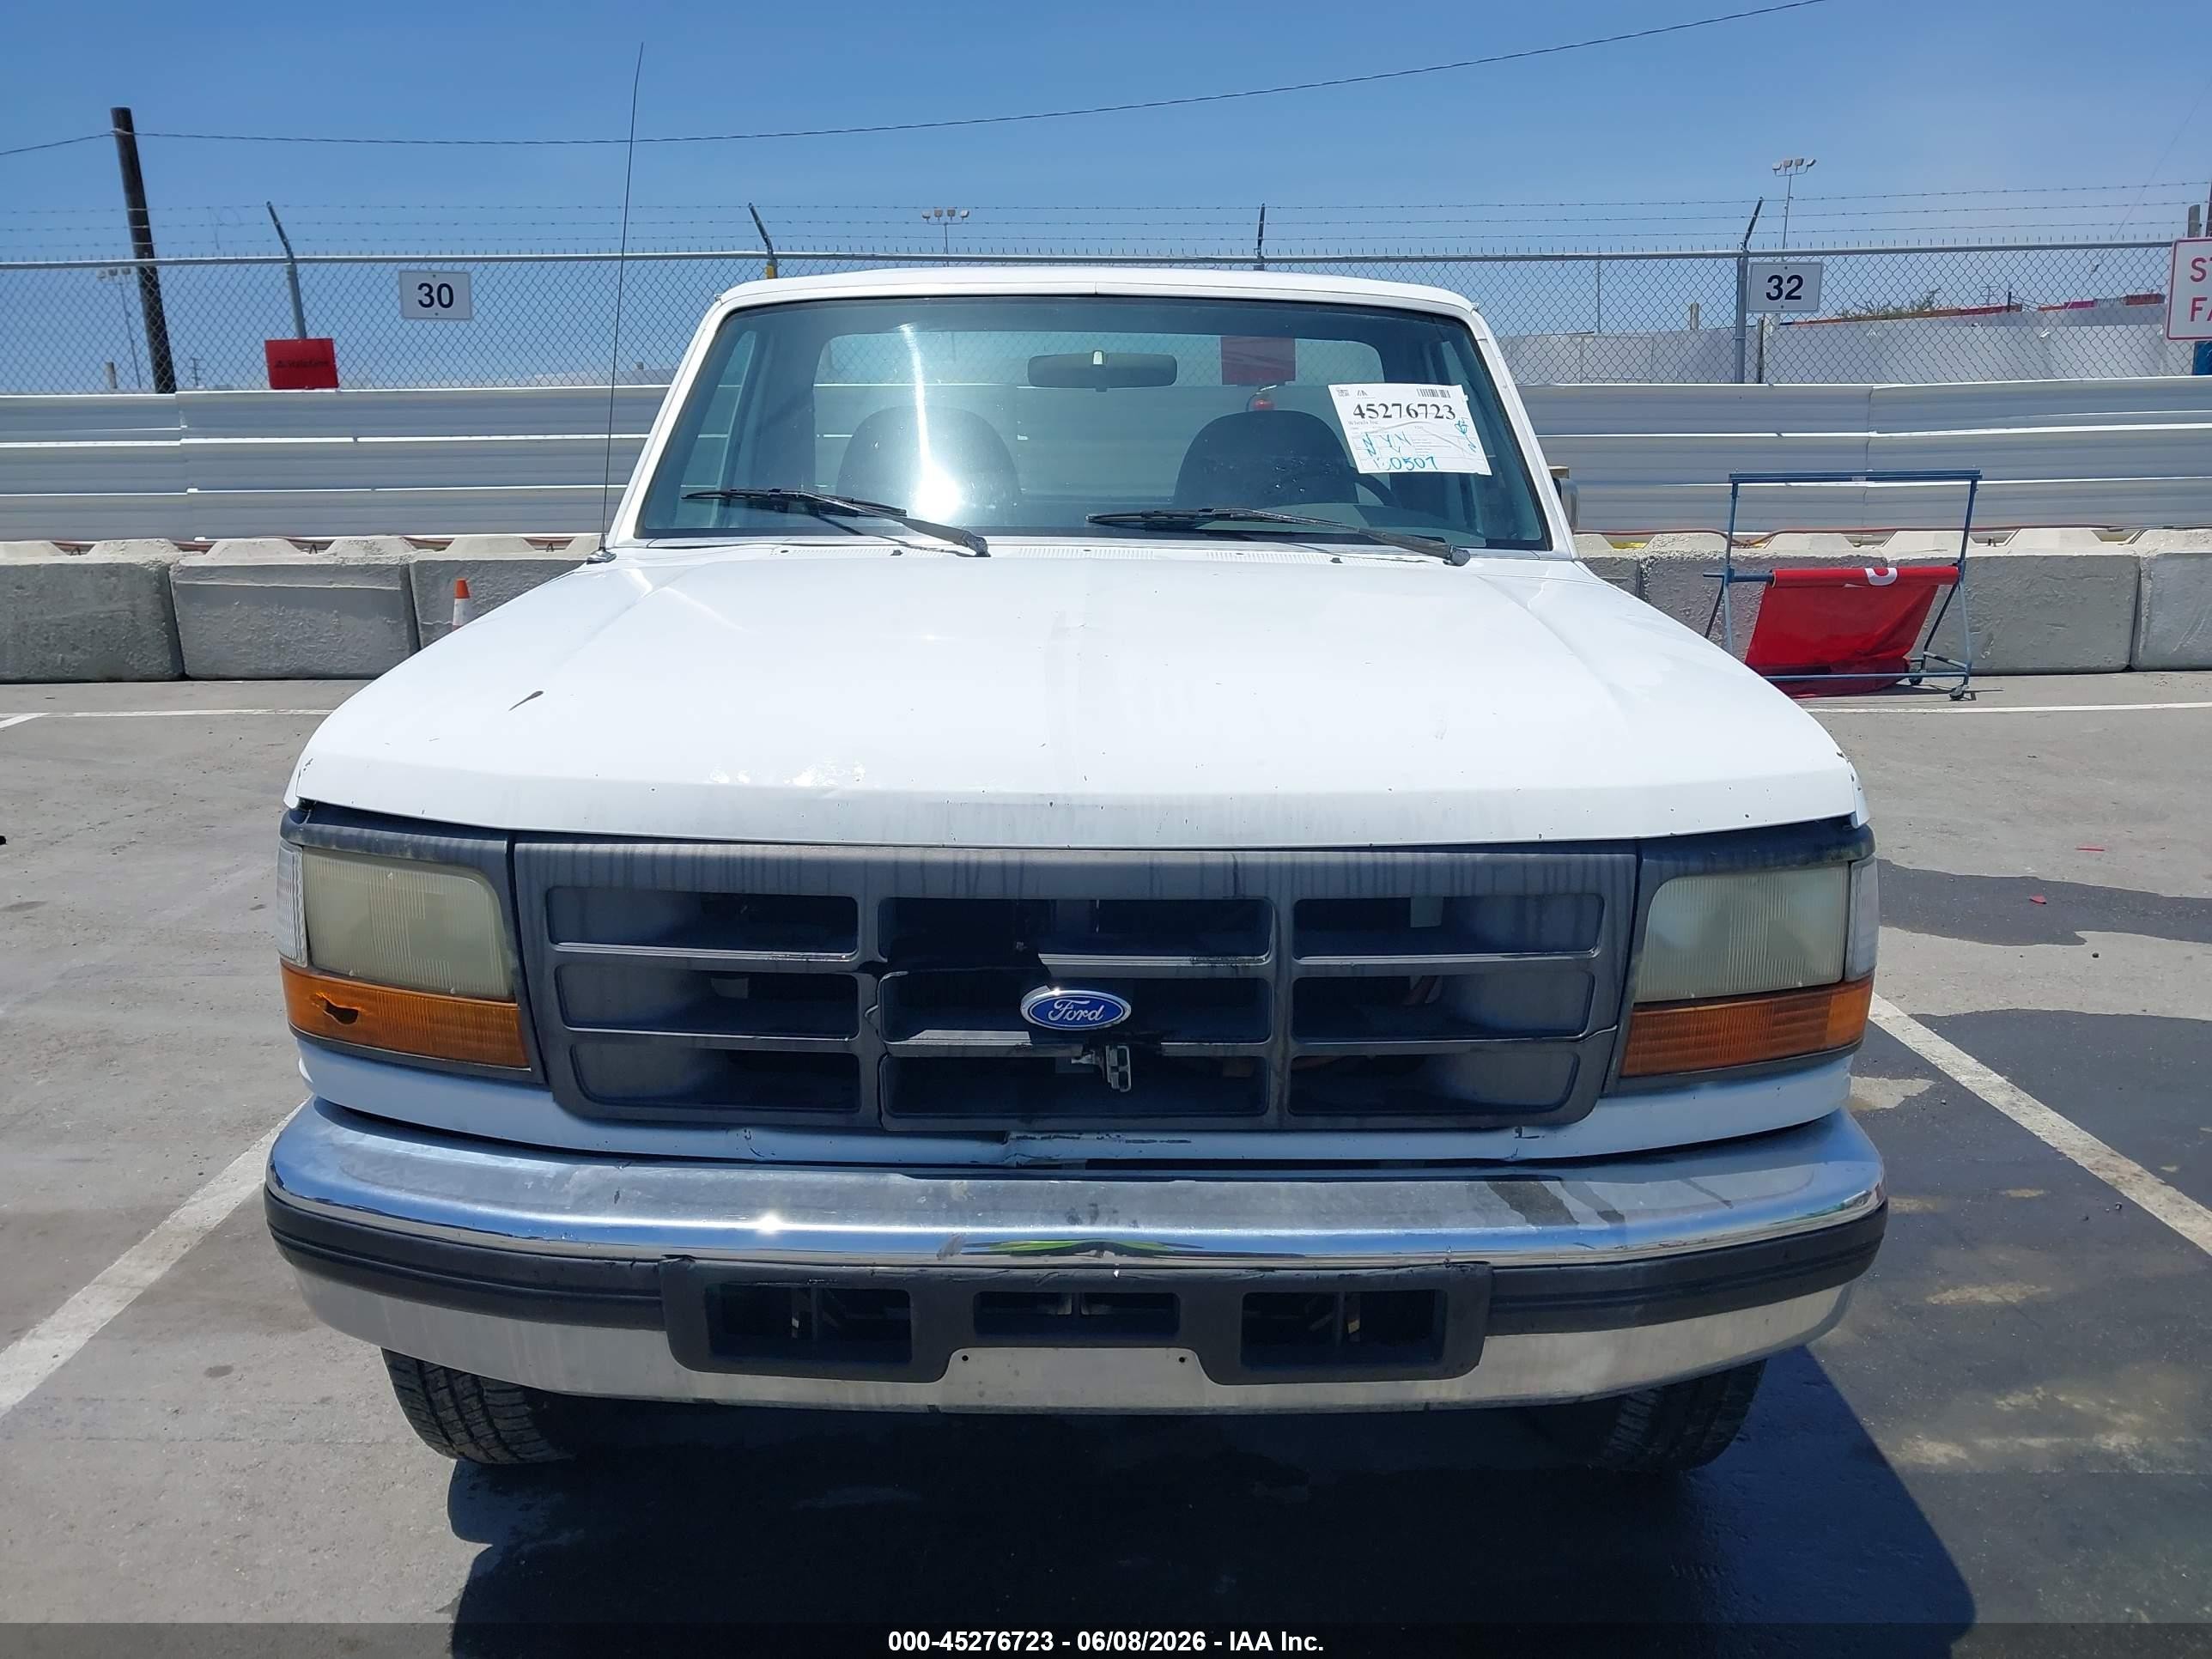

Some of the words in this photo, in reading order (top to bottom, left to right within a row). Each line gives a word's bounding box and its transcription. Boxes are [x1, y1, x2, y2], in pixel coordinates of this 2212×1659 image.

[2190, 257, 2212, 283] S
[417, 282, 454, 309] 30
[1765, 274, 1803, 301] 32
[2190, 296, 2212, 322] F
[1352, 402, 1456, 421] 45276723
[1048, 999, 1105, 1021] Ford
